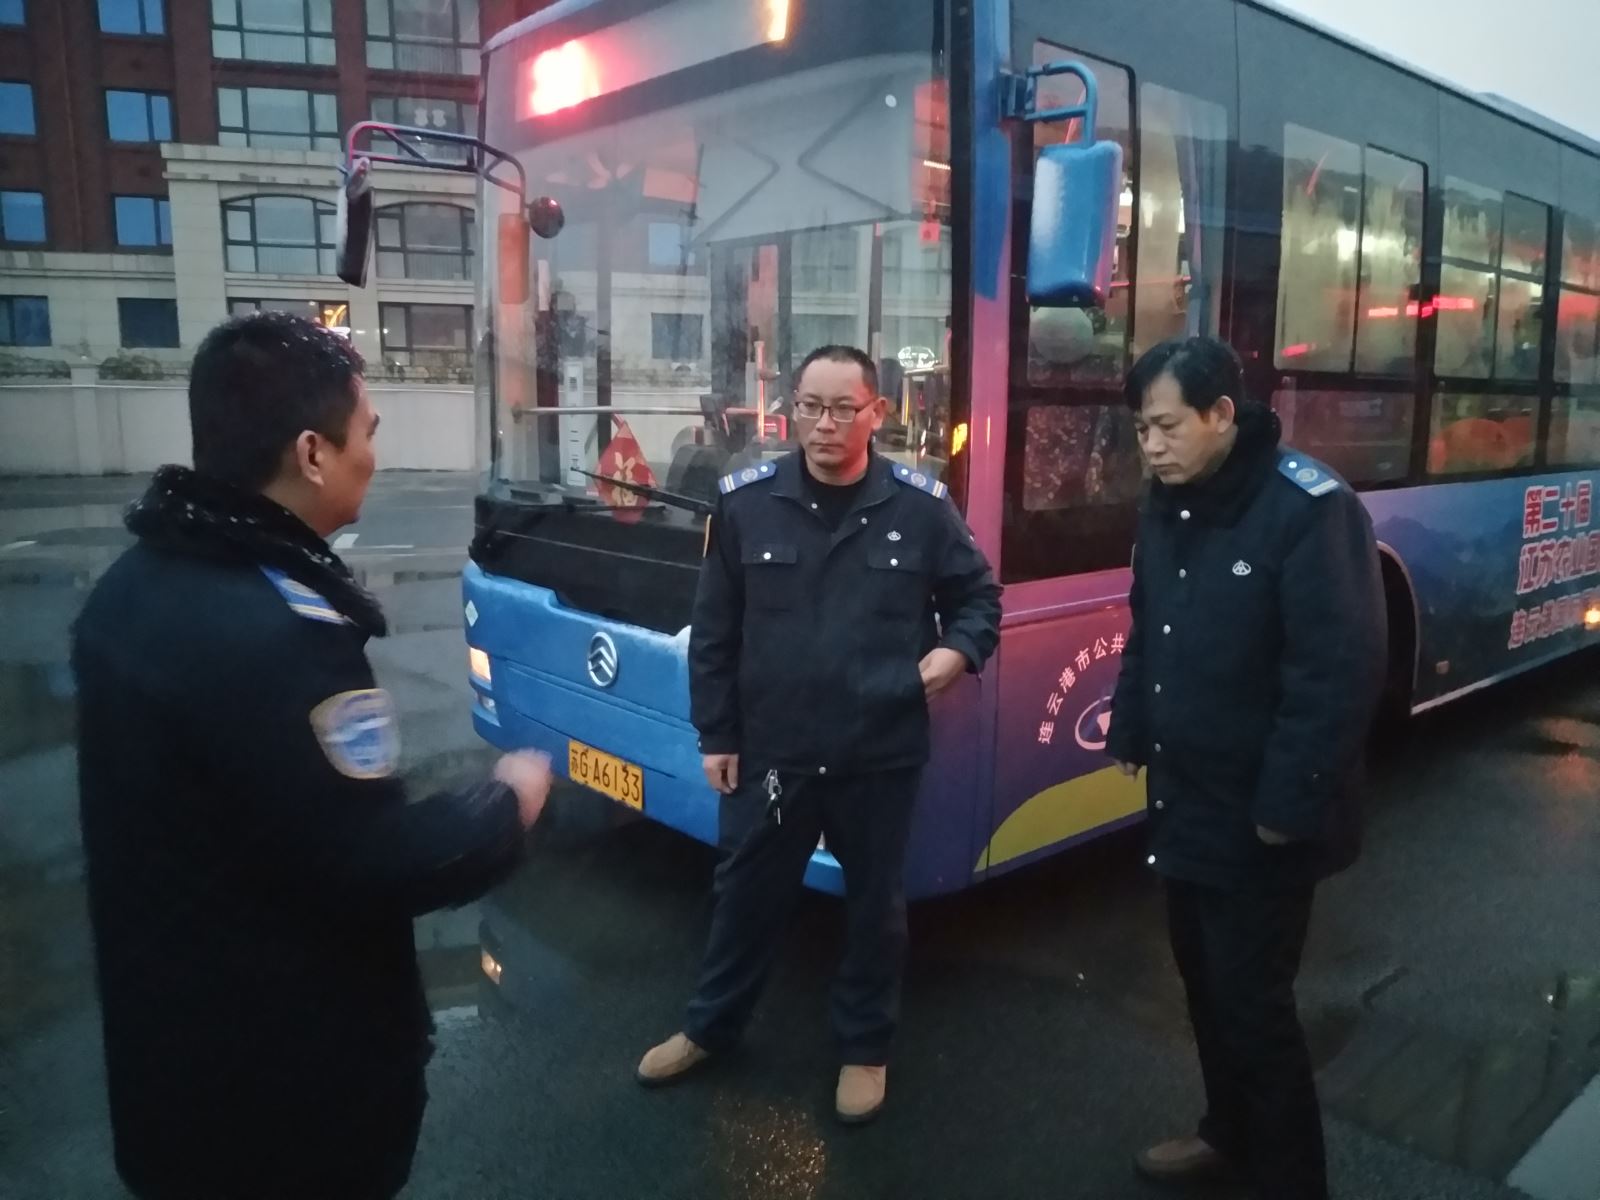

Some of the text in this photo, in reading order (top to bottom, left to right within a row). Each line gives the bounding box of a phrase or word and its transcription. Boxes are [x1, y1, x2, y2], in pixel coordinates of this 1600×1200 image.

[1523, 480, 1592, 538] 第二十届
[1038, 633, 1125, 744] 连云港市公共
